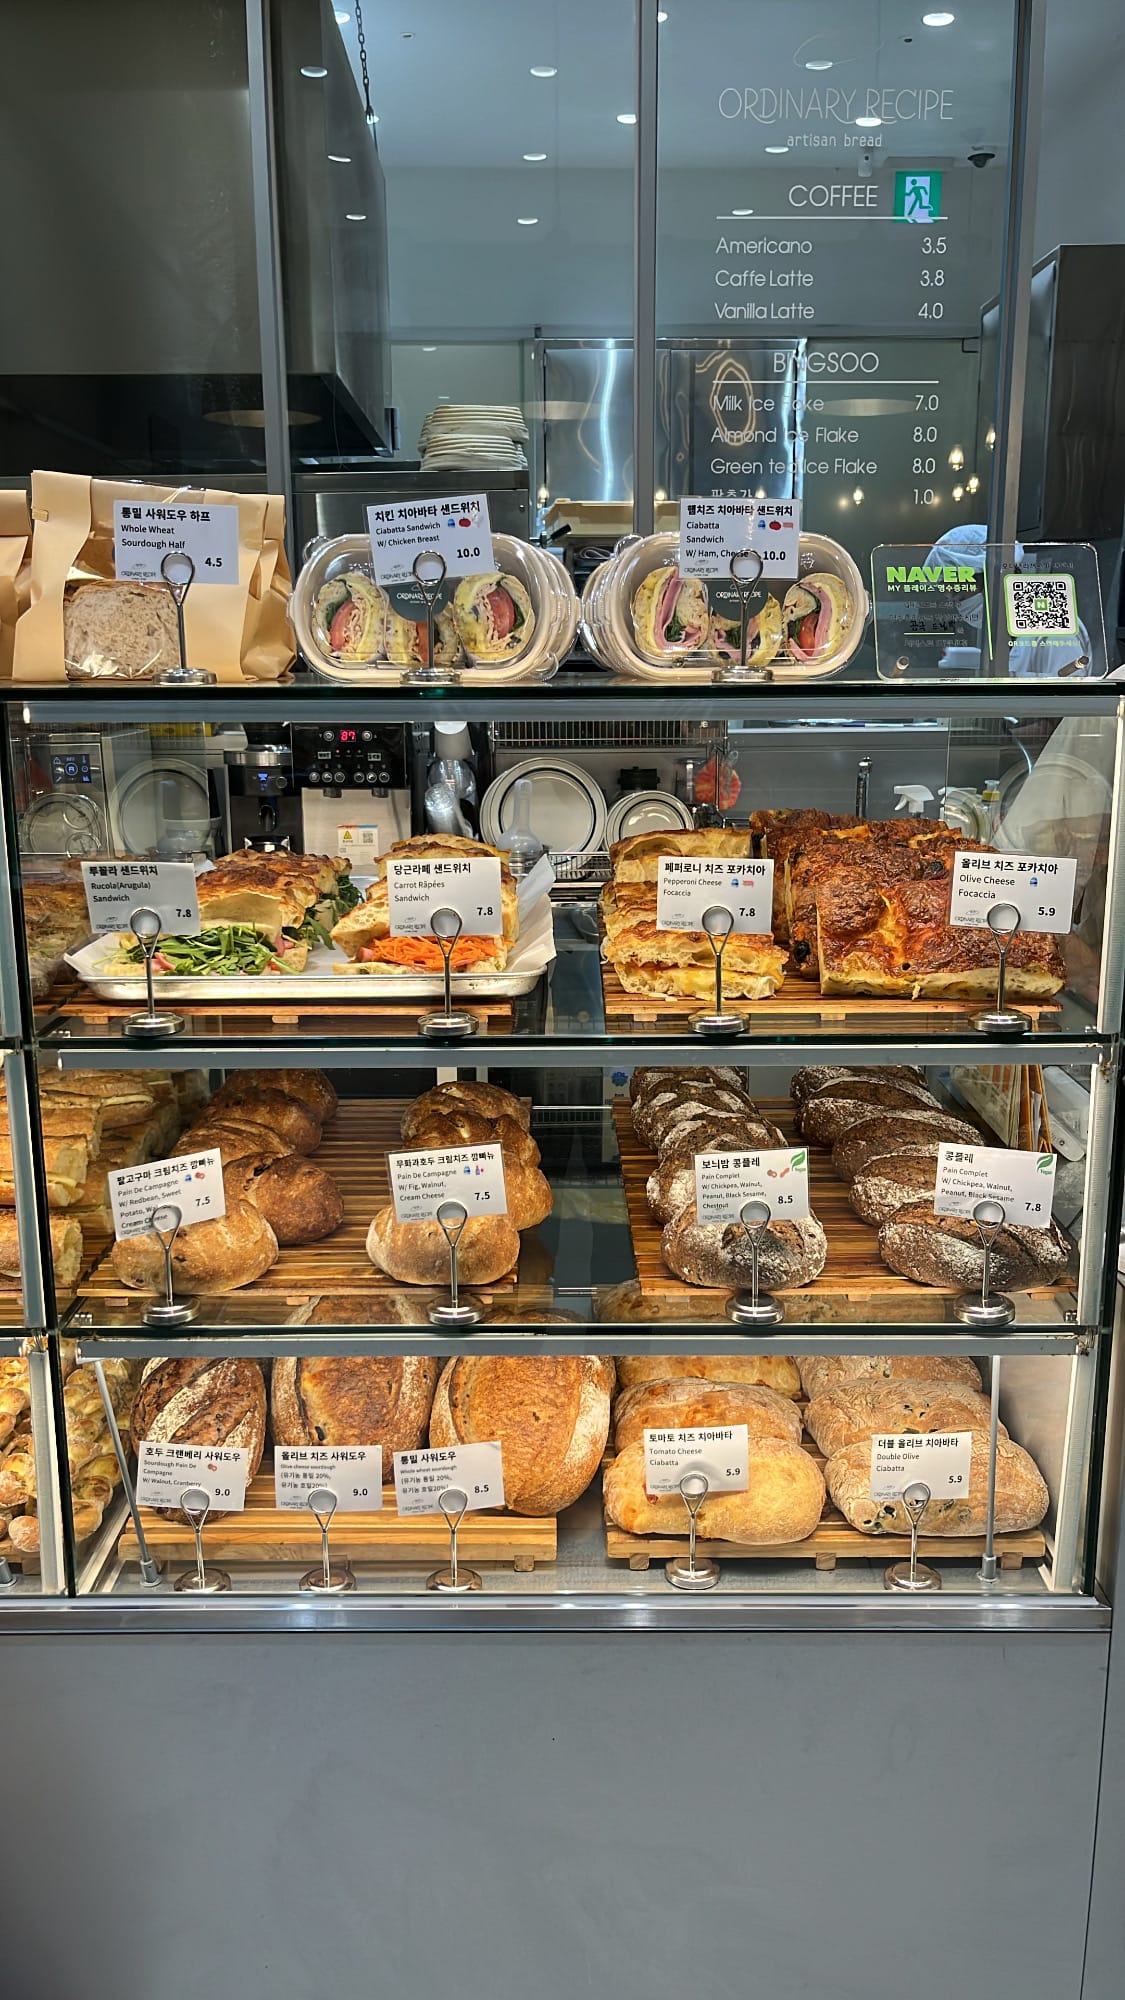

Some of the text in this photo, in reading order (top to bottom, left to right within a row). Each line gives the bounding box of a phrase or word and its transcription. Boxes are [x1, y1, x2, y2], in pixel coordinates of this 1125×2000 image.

[718, 88, 954, 124] ORDINARY RECIPE
[787, 134, 882, 147] artisan bread
[789, 185, 879, 207] COFFEE
[716, 238, 812, 254] Americano
[921, 238, 947, 254] 3.5
[716, 271, 814, 287] Caffe Latte
[920, 270, 944, 286] 3.8
[715, 304, 814, 319] Vanilla Latte
[918, 303, 943, 319] 4.0
[713, 395, 742, 411] Milk
[915, 395, 939, 411] 7.0
[711, 427, 859, 443] Almond Flake
[913, 427, 937, 443] 8.0
[711, 459, 763, 474] Green
[805, 459, 829, 474] Ice
[835, 459, 877, 474] Flake
[912, 458, 936, 474] 8.0
[914, 489, 934, 505] 1.0
[121, 507, 211, 522] 통밀 사워도우 하프
[375, 501, 480, 522] 치킨 치아바타 샌드위치
[688, 505, 792, 516] 햄치즈 치아바타 샌드위치
[121, 525, 175, 534] Whole Wheat
[376, 521, 440, 535] Ciabatta Sandwich
[122, 539, 166, 549] Sourdough
[377, 535, 440, 548] W/ Chicken Breast
[457, 547, 480, 558] 10.0
[686, 550, 718, 558] W/ Ham,
[763, 551, 786, 560] 10.0
[205, 557, 222, 567] 4.5
[886, 567, 976, 582] NAVER
[341, 731, 355, 741] 87
[89, 866, 158, 876] 루꼴라 샌드위치
[394, 863, 471, 875] 당근라페 샌드위치
[665, 862, 765, 875] 페퍼로니 치즈 포카치아
[961, 858, 1058, 874] 올리브 치즈 포카치아
[664, 878, 696, 886] Pepperoni
[960, 875, 1015, 885] Olive Cheese
[93, 894, 130, 902] Sandwich
[394, 894, 429, 902] Sandwich
[959, 889, 996, 899] Focaccia
[176, 909, 192, 917] 7.8
[477, 907, 493, 915] 7.8
[739, 907, 755, 917] 7.8
[1038, 907, 1056, 916] 5.9
[438, 1154, 468, 1164] 크림치즈
[702, 1159, 729, 1169] 보늬밤
[154, 1163, 188, 1178] 크림치즈
[397, 1172, 411, 1180] Pain
[423, 1170, 457, 1178] Campagne
[952, 1179, 985, 1189] Chickpea,
[987, 1183, 1013, 1191] Walnut,
[118, 1189, 132, 1197] Pain
[422, 1192, 445, 1200] Cheese
[474, 1192, 490, 1201] 7.5
[941, 1188, 966, 1198] Peanut,
[988, 1194, 1015, 1202] Sesame
[195, 1196, 210, 1206] 7.5
[777, 1195, 793, 1204] 8.5
[1025, 1202, 1041, 1212] 7.8
[649, 1431, 732, 1442] 토마토 치즈 치아바타
[878, 1438, 958, 1448] 더블 올리브 치아바타
[145, 1447, 240, 1461] 호두 크랜베리 사워도우
[281, 1451, 366, 1461] 올리브 치즈 사워도우
[401, 1451, 456, 1465] 통밀 사워도우
[726, 1468, 740, 1476] 5.9
[948, 1475, 962, 1483] 5.9
[215, 1488, 230, 1496] 9.0
[353, 1488, 368, 1496] 9.0
[474, 1484, 489, 1493] 8.5
